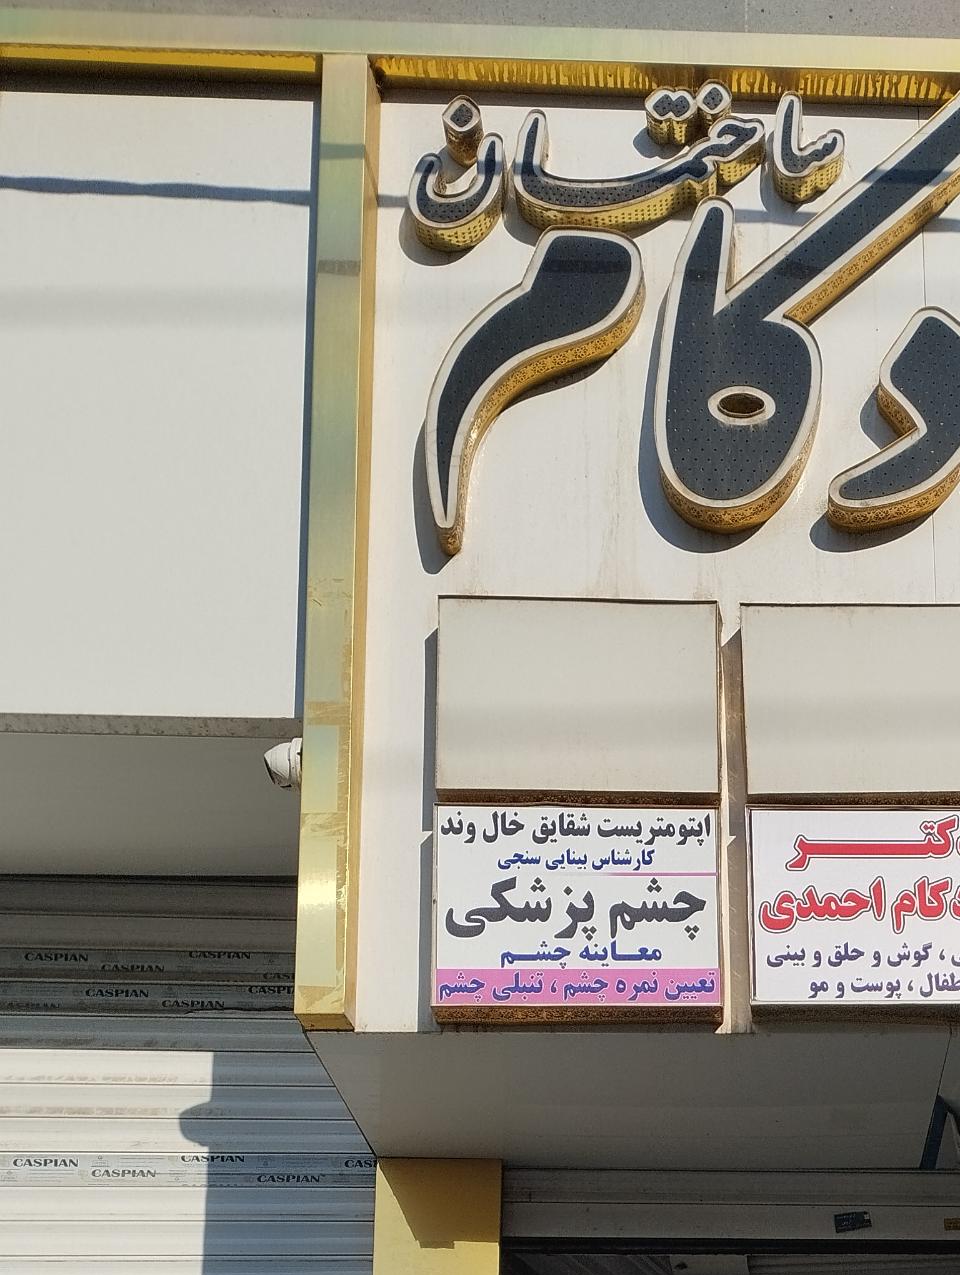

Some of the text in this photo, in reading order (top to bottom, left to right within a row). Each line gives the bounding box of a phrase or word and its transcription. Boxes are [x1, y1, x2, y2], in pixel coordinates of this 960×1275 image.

[407, 78, 845, 253] ساختمان
[440, 810, 711, 846] اپتومتریست شقایق خال وند
[497, 848, 655, 871] کارشناس بینایی سنجی
[445, 876, 707, 941] چشم پزشکی
[758, 875, 887, 933] احمدی
[24, 952, 89, 962] CASPIAN
[500, 939, 663, 969] معاینه چشم
[766, 944, 806, 968] بینی
[812, 951, 822, 967] و
[827, 941, 865, 968] حلق
[871, 951, 881, 967] و
[887, 942, 933, 968] گوش
[85, 988, 149, 998] CASPIAN
[439, 972, 486, 1002] چشم
[492, 971, 544, 1001] تنبلی
[563, 972, 609, 1002] چشم
[615, 972, 658, 1000] نمره
[664, 972, 716, 1000] تعیین
[807, 982, 829, 999] مو
[836, 982, 844, 998] و
[850, 976, 902, 999] پوست
[162, 1000, 225, 1008] CASPIAN
[13, 1158, 79, 1168] CASPIAN
[91, 1169, 157, 1178] CASPIAN
